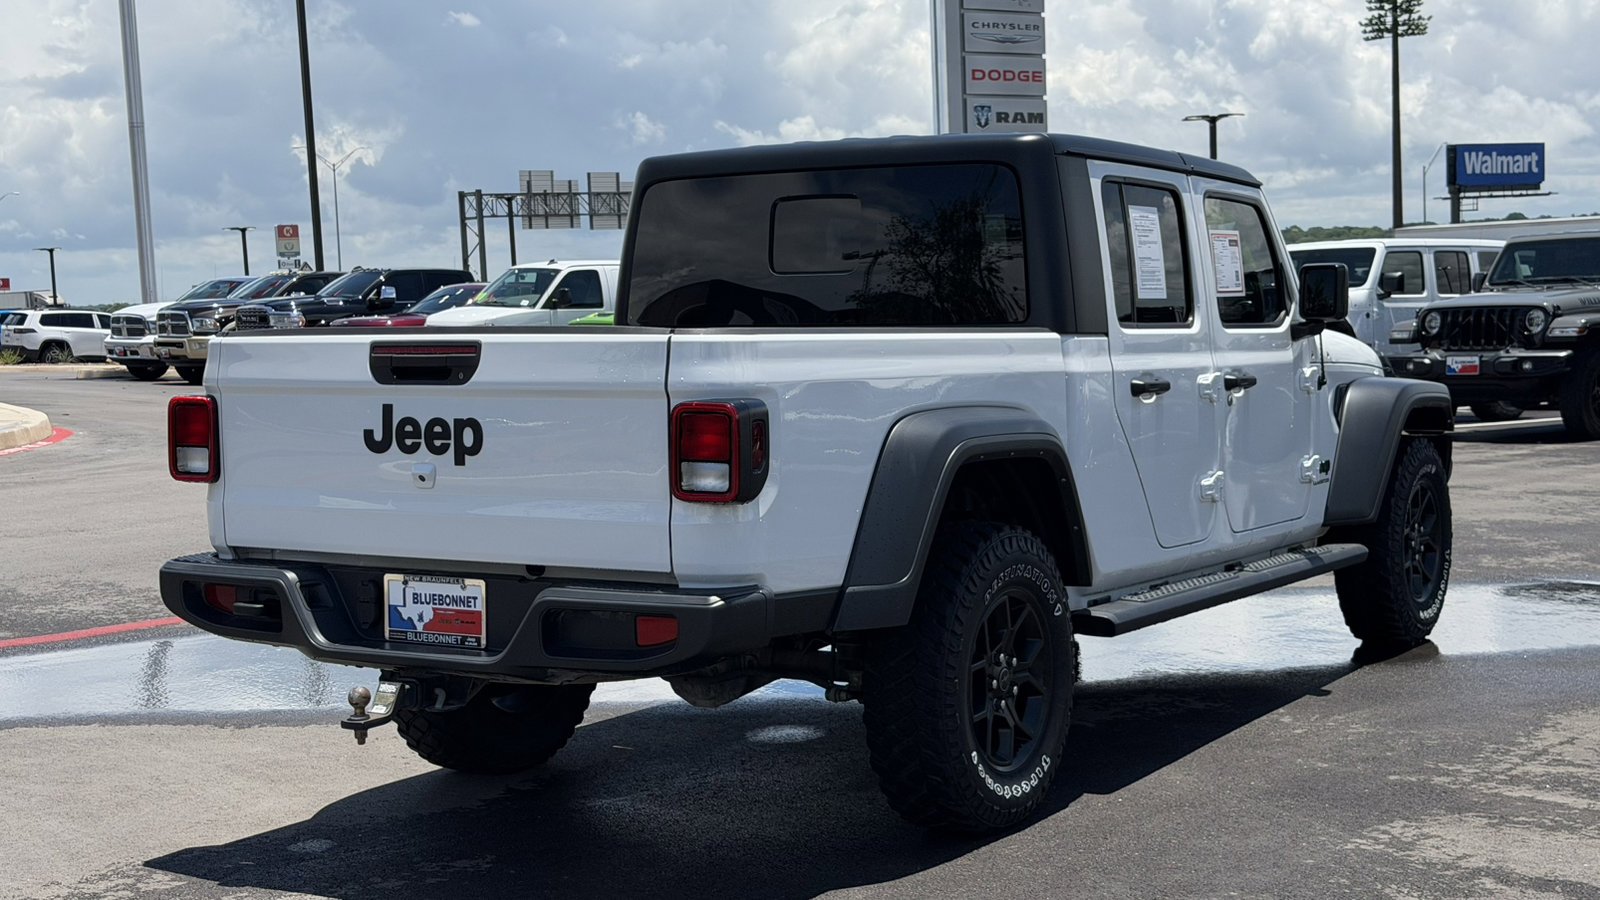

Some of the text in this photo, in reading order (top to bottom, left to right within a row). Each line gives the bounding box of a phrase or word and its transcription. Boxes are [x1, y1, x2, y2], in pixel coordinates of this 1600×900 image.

[971, 21, 1040, 31] CHRYSLER
[971, 69, 1043, 82] DODGE
[996, 111, 1044, 124] RAM
[1463, 151, 1539, 174] Walmart
[363, 403, 484, 466] Jeep
[984, 563, 1058, 606] DESTINATION
[412, 592, 478, 609] BLUEBONNET
[406, 632, 462, 645] BLUEBONNET
[977, 755, 1052, 800] Firestone
